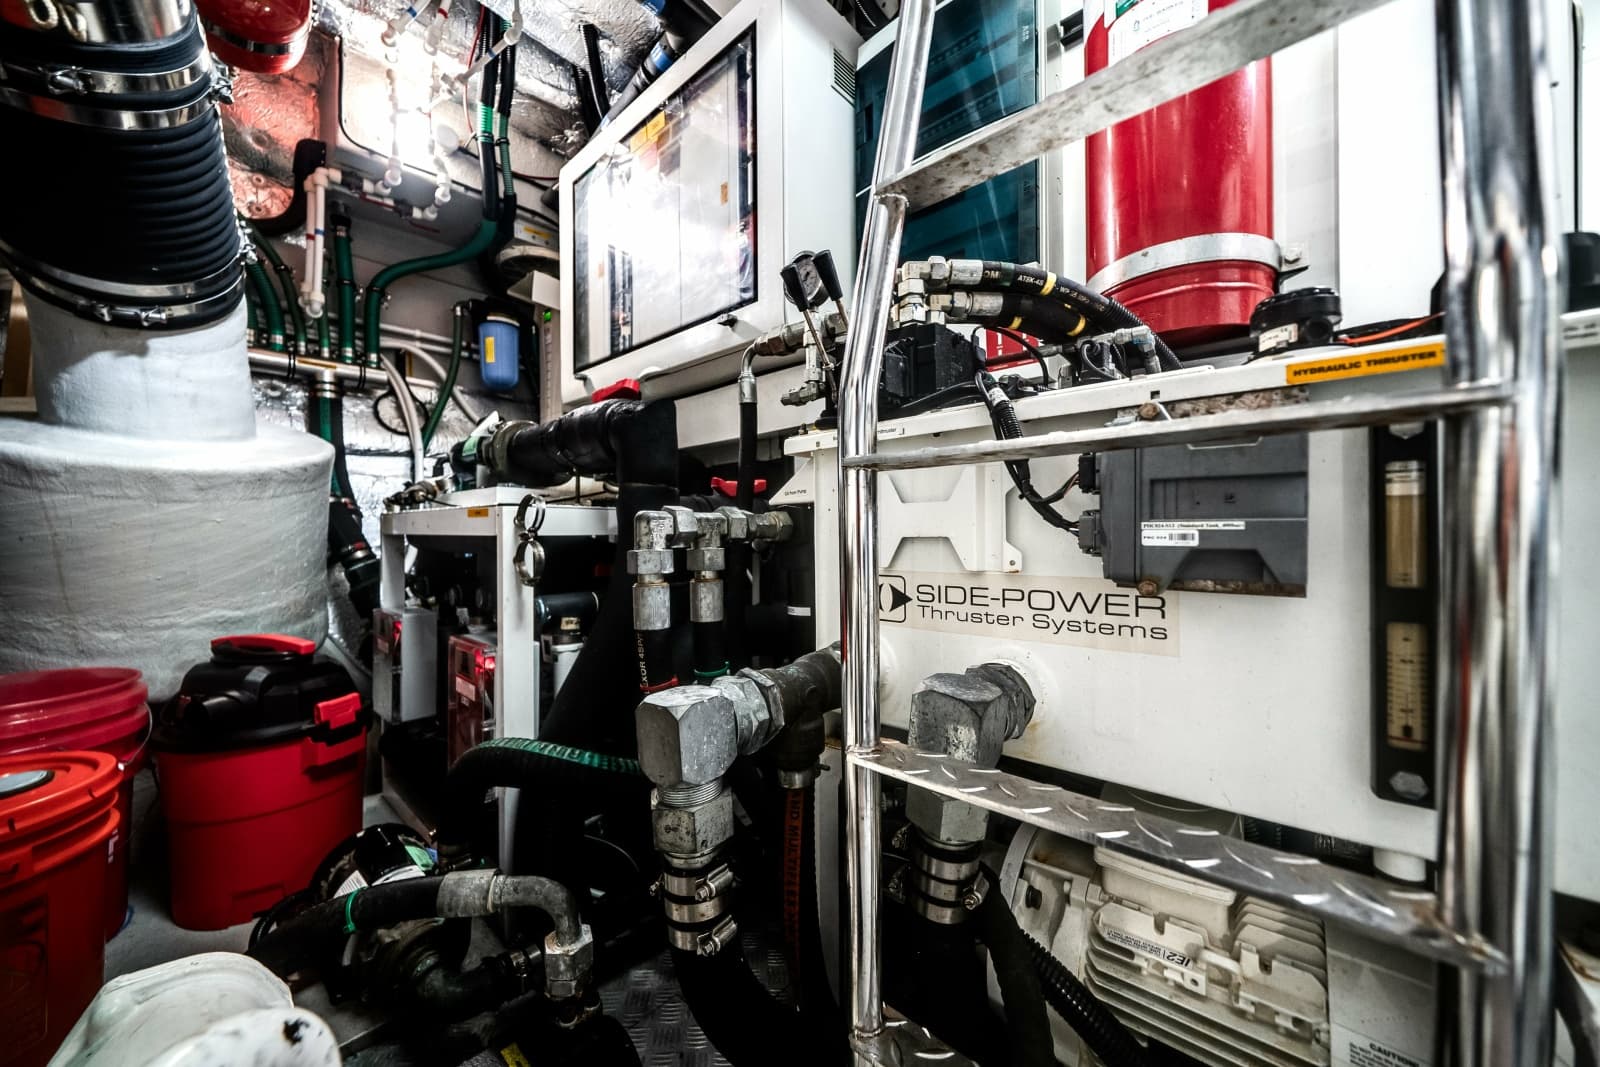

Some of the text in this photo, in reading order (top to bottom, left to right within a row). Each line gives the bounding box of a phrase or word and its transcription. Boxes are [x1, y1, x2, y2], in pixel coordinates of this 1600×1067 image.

[1293, 350, 1437, 377] HYDRAULIC THRUSTER
[916, 583, 1167, 619] SIDE-POWER
[917, 604, 1168, 640] Thruster Systems
[1166, 951, 1191, 967] IE2
